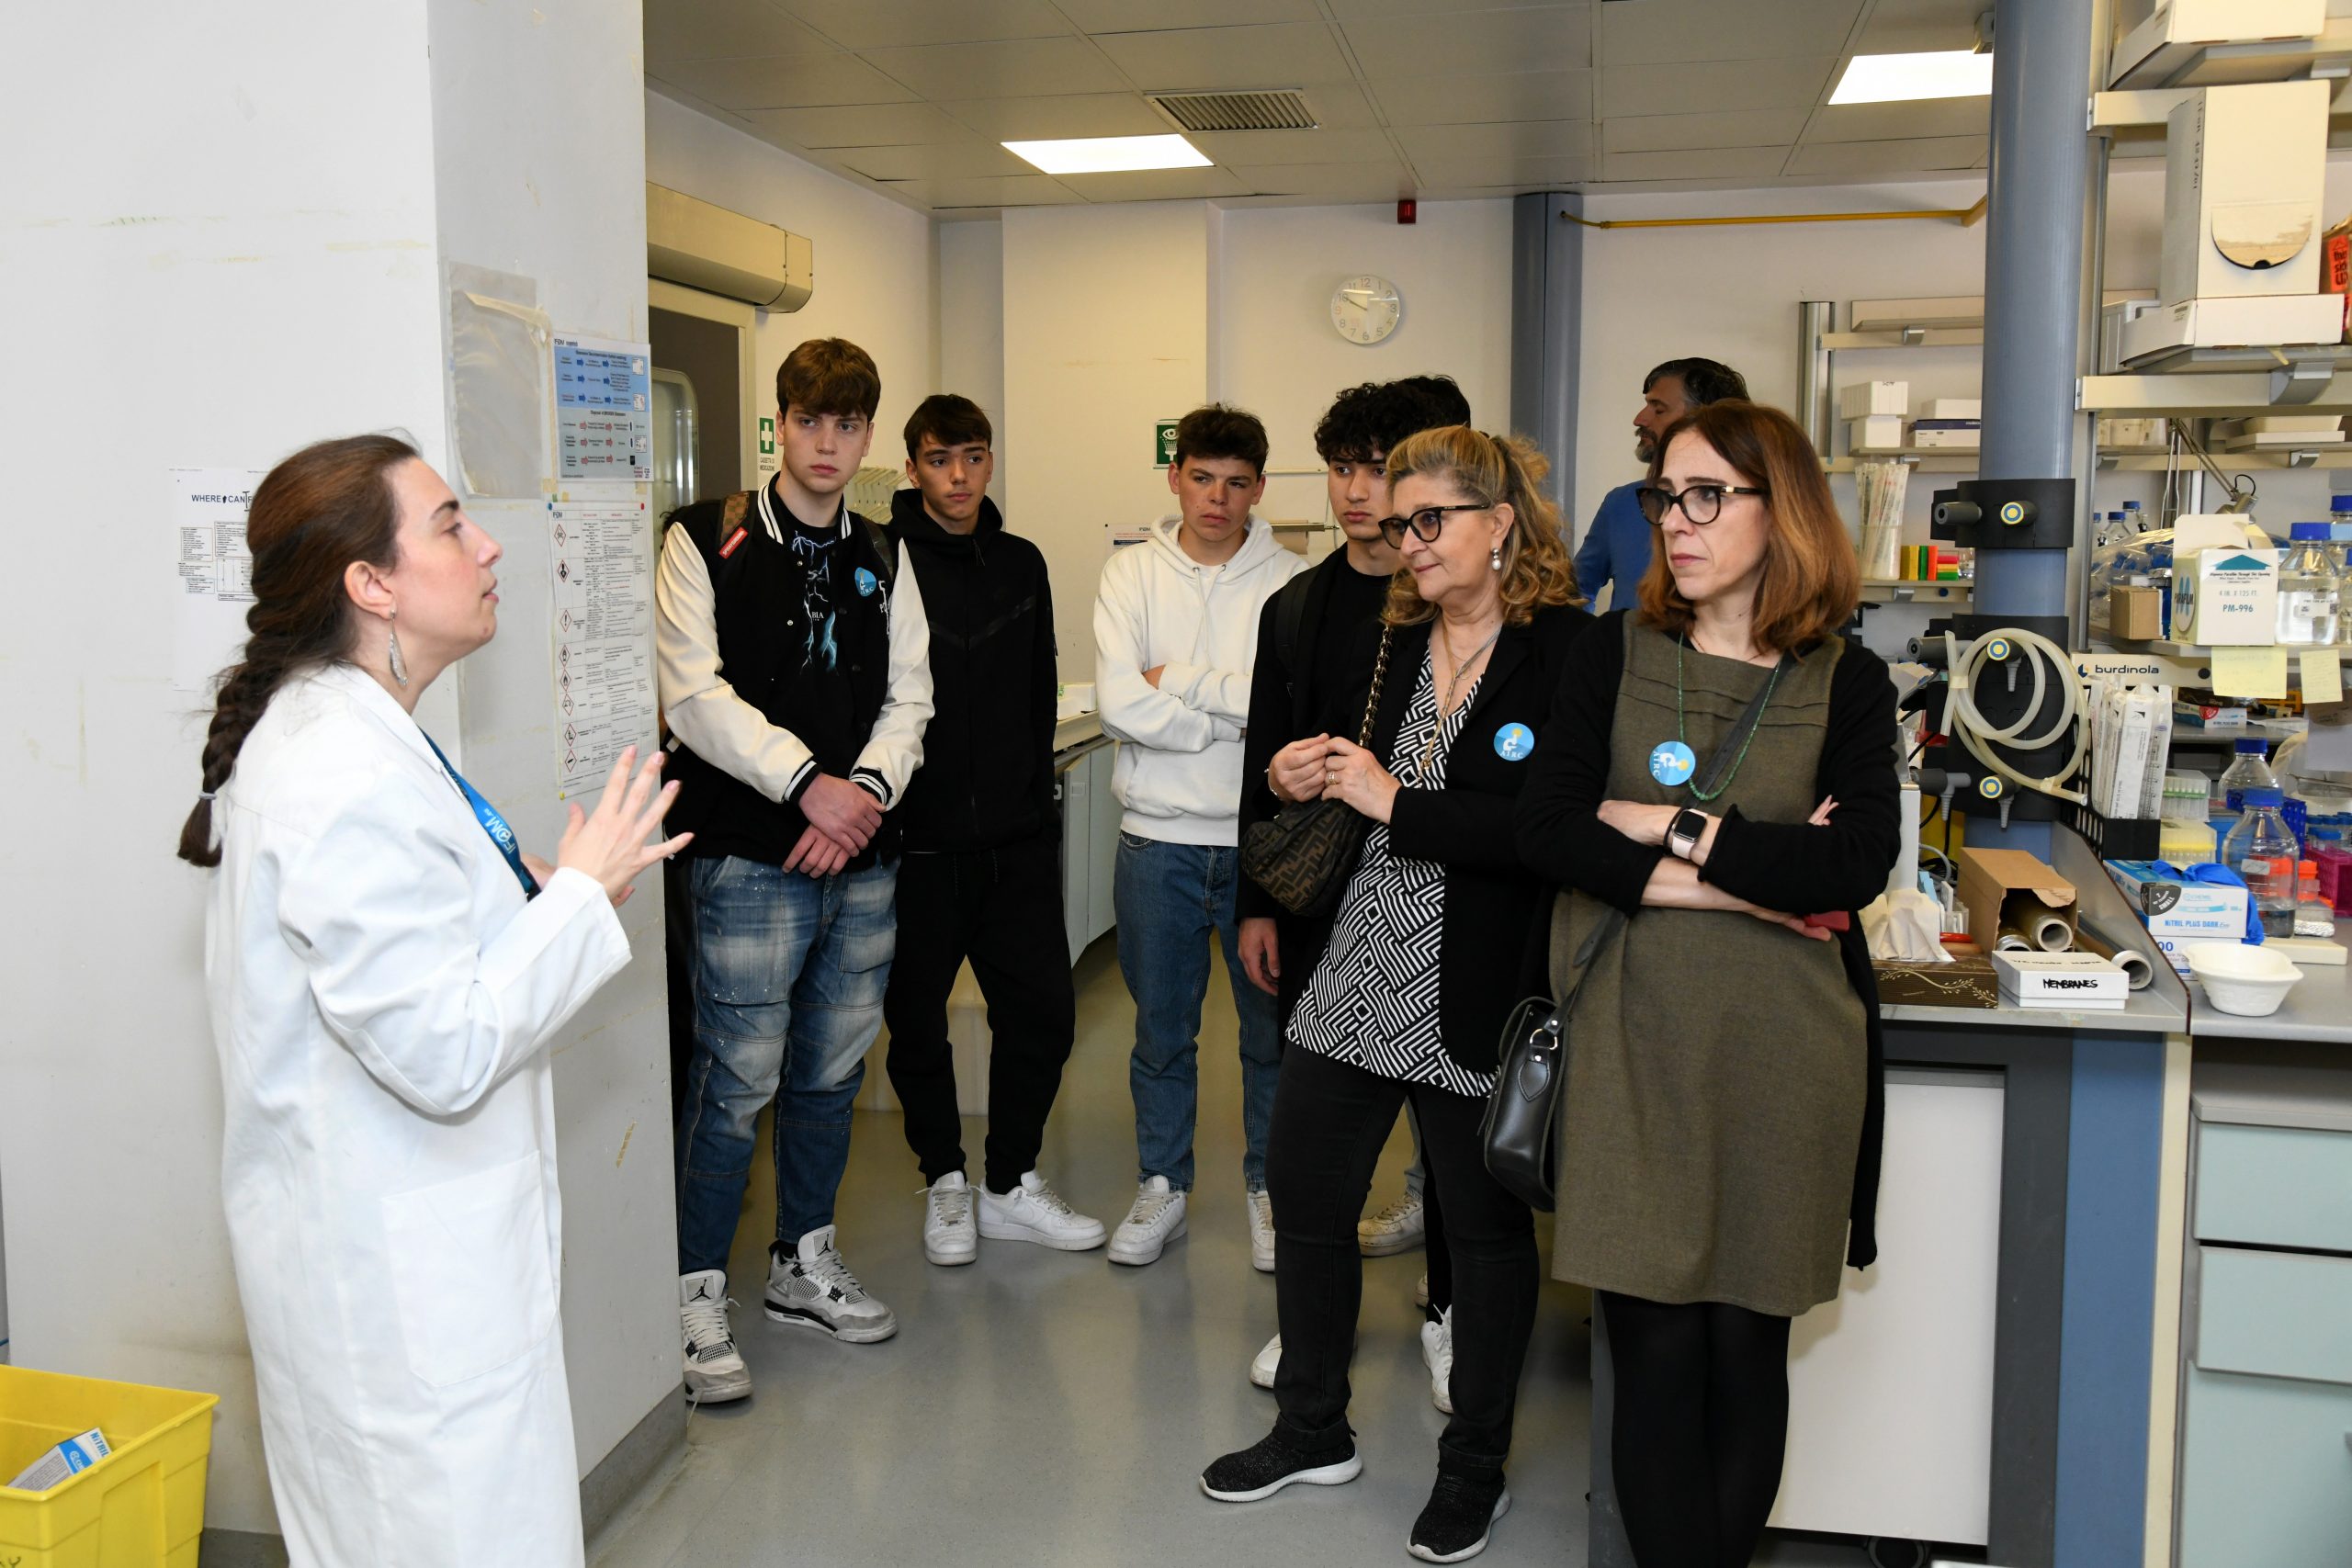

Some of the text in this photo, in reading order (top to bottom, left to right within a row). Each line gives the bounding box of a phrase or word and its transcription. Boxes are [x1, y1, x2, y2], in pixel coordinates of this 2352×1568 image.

[1360, 277, 1371, 288] 12
[1338, 293, 1349, 302] 10
[1385, 290, 1393, 299] 2
[1334, 305, 1342, 315] 9
[1390, 303, 1397, 313] 3
[1339, 319, 1346, 328] 8
[1385, 318, 1393, 326] 4
[1350, 328, 1356, 337] 7
[1376, 327, 1384, 336] 5
[1362, 332, 1370, 341] 6
[191, 494, 221, 502] WHERE
[228, 495, 245, 503] CAN
[2222, 604, 2254, 613] PM-996
[2095, 664, 2159, 674] burdinola
[1499, 750, 1523, 759] AIRC
